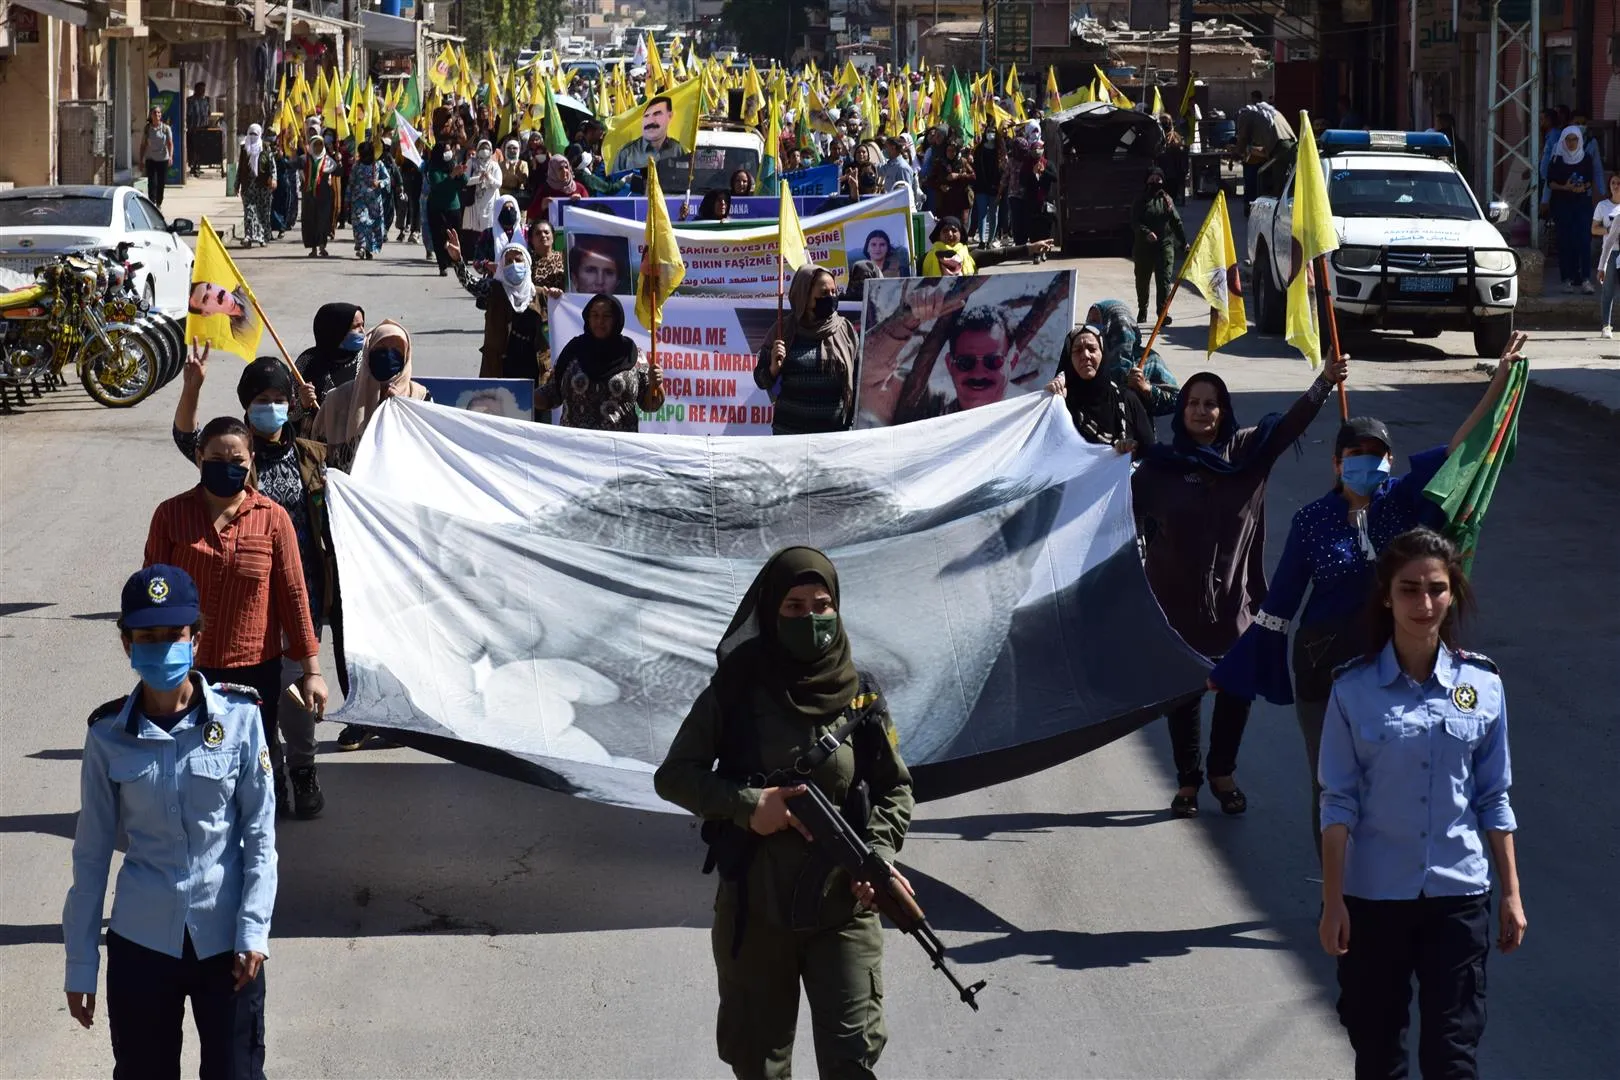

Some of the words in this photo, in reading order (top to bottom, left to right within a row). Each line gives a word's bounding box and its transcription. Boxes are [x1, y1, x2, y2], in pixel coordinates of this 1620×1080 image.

[806, 230, 840, 246] OŞÎNÊ
[692, 260, 722, 269] BIKIN
[705, 327, 727, 346] ME
[662, 378, 692, 399] RÇA
[695, 378, 737, 398] BIKIN
[688, 404, 707, 422] RE
[751, 405, 775, 424] BIJ
